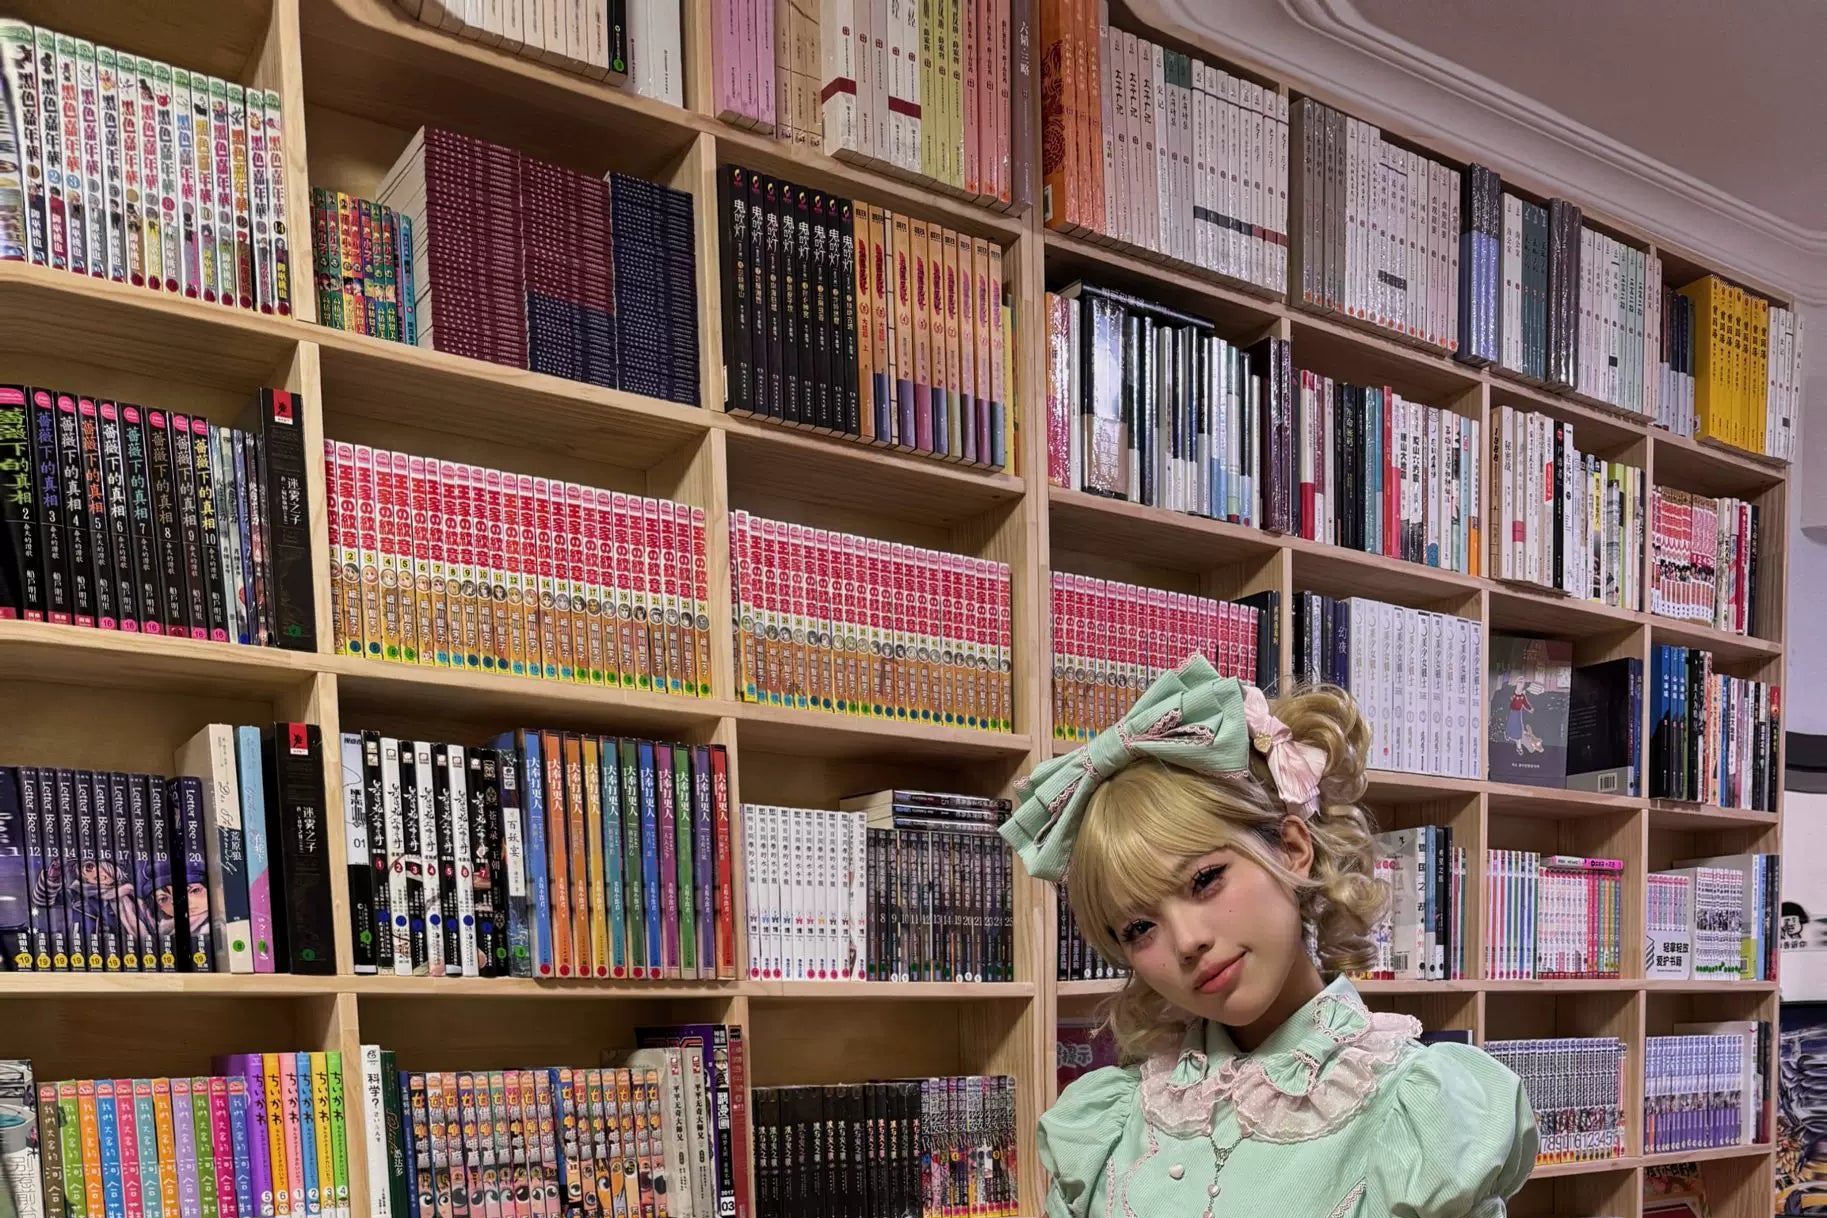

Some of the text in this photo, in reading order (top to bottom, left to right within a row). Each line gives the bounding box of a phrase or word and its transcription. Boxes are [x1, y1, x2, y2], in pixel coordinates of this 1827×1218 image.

[734, 199, 745, 239] 鬼吹灯
[752, 205, 763, 246] 鬼吹灯
[767, 213, 778, 252] 鬼吹灯
[783, 214, 794, 254] 鬼吹灯
[799, 221, 809, 261] 鬼吹灯
[814, 225, 824, 265] 鬼吹灯
[829, 229, 840, 268] 鬼吹灯
[843, 235, 853, 272] 鬼吹灯
[36, 411, 59, 508] 薔薇下的真相
[60, 416, 82, 511] 薔薇下的真相
[82, 419, 104, 514] 薔薇下的真相
[102, 424, 125, 518] 薔薇下的真相
[126, 426, 148, 520] 薔薇下的真相
[152, 432, 174, 524] 薔薇下的真相
[174, 435, 196, 527] 薔薇下的真相
[194, 439, 216, 544] 薔薇下的真相 10
[287, 478, 301, 526] 迷雾之子
[1338, 627, 1347, 654] 幻夜
[530, 757, 542, 809] 大奉打更人
[551, 759, 563, 810] 大奉打更人
[571, 763, 582, 814] 大奉打更人
[588, 764, 599, 815] 大奉打更人
[607, 766, 619, 816] 大奉打更人
[627, 766, 638, 816] 大奉打更人
[644, 767, 655, 818] 大奉打更人
[662, 769, 673, 819] 大奉打更人
[679, 771, 690, 821] 大奉打更人
[700, 772, 710, 821] 大奉打更人
[717, 773, 728, 822] 大奉打更人
[24, 780, 40, 856] Letter Bee 12
[42, 780, 59, 857] Letter Bee 13
[60, 781, 76, 857] Letter Bee 14
[79, 784, 94, 859] Letter Bee 15
[113, 785, 130, 859] Letter Bee 17
[152, 787, 168, 861] Letter Bee 19
[186, 789, 201, 862] Letter Bee 20
[303, 807, 317, 852] 迷雾之子
[353, 838, 367, 848] 01
[231, 831, 242, 861] 荒原狼
[911, 915, 918, 924] 11
[1656, 956, 1682, 967] 爱护书籍
[1663, 942, 1689, 953] 轻拿轻放
[252, 1073, 268, 1126] ちいかわ
[268, 1073, 283, 1125] ちいかわ
[286, 1072, 300, 1125] ちいかわ
[300, 1072, 314, 1125] ちいかわ
[316, 1071, 330, 1124] ちいかわ
[330, 1071, 344, 1123] ちいかわ
[722, 1200, 735, 1212] 03
